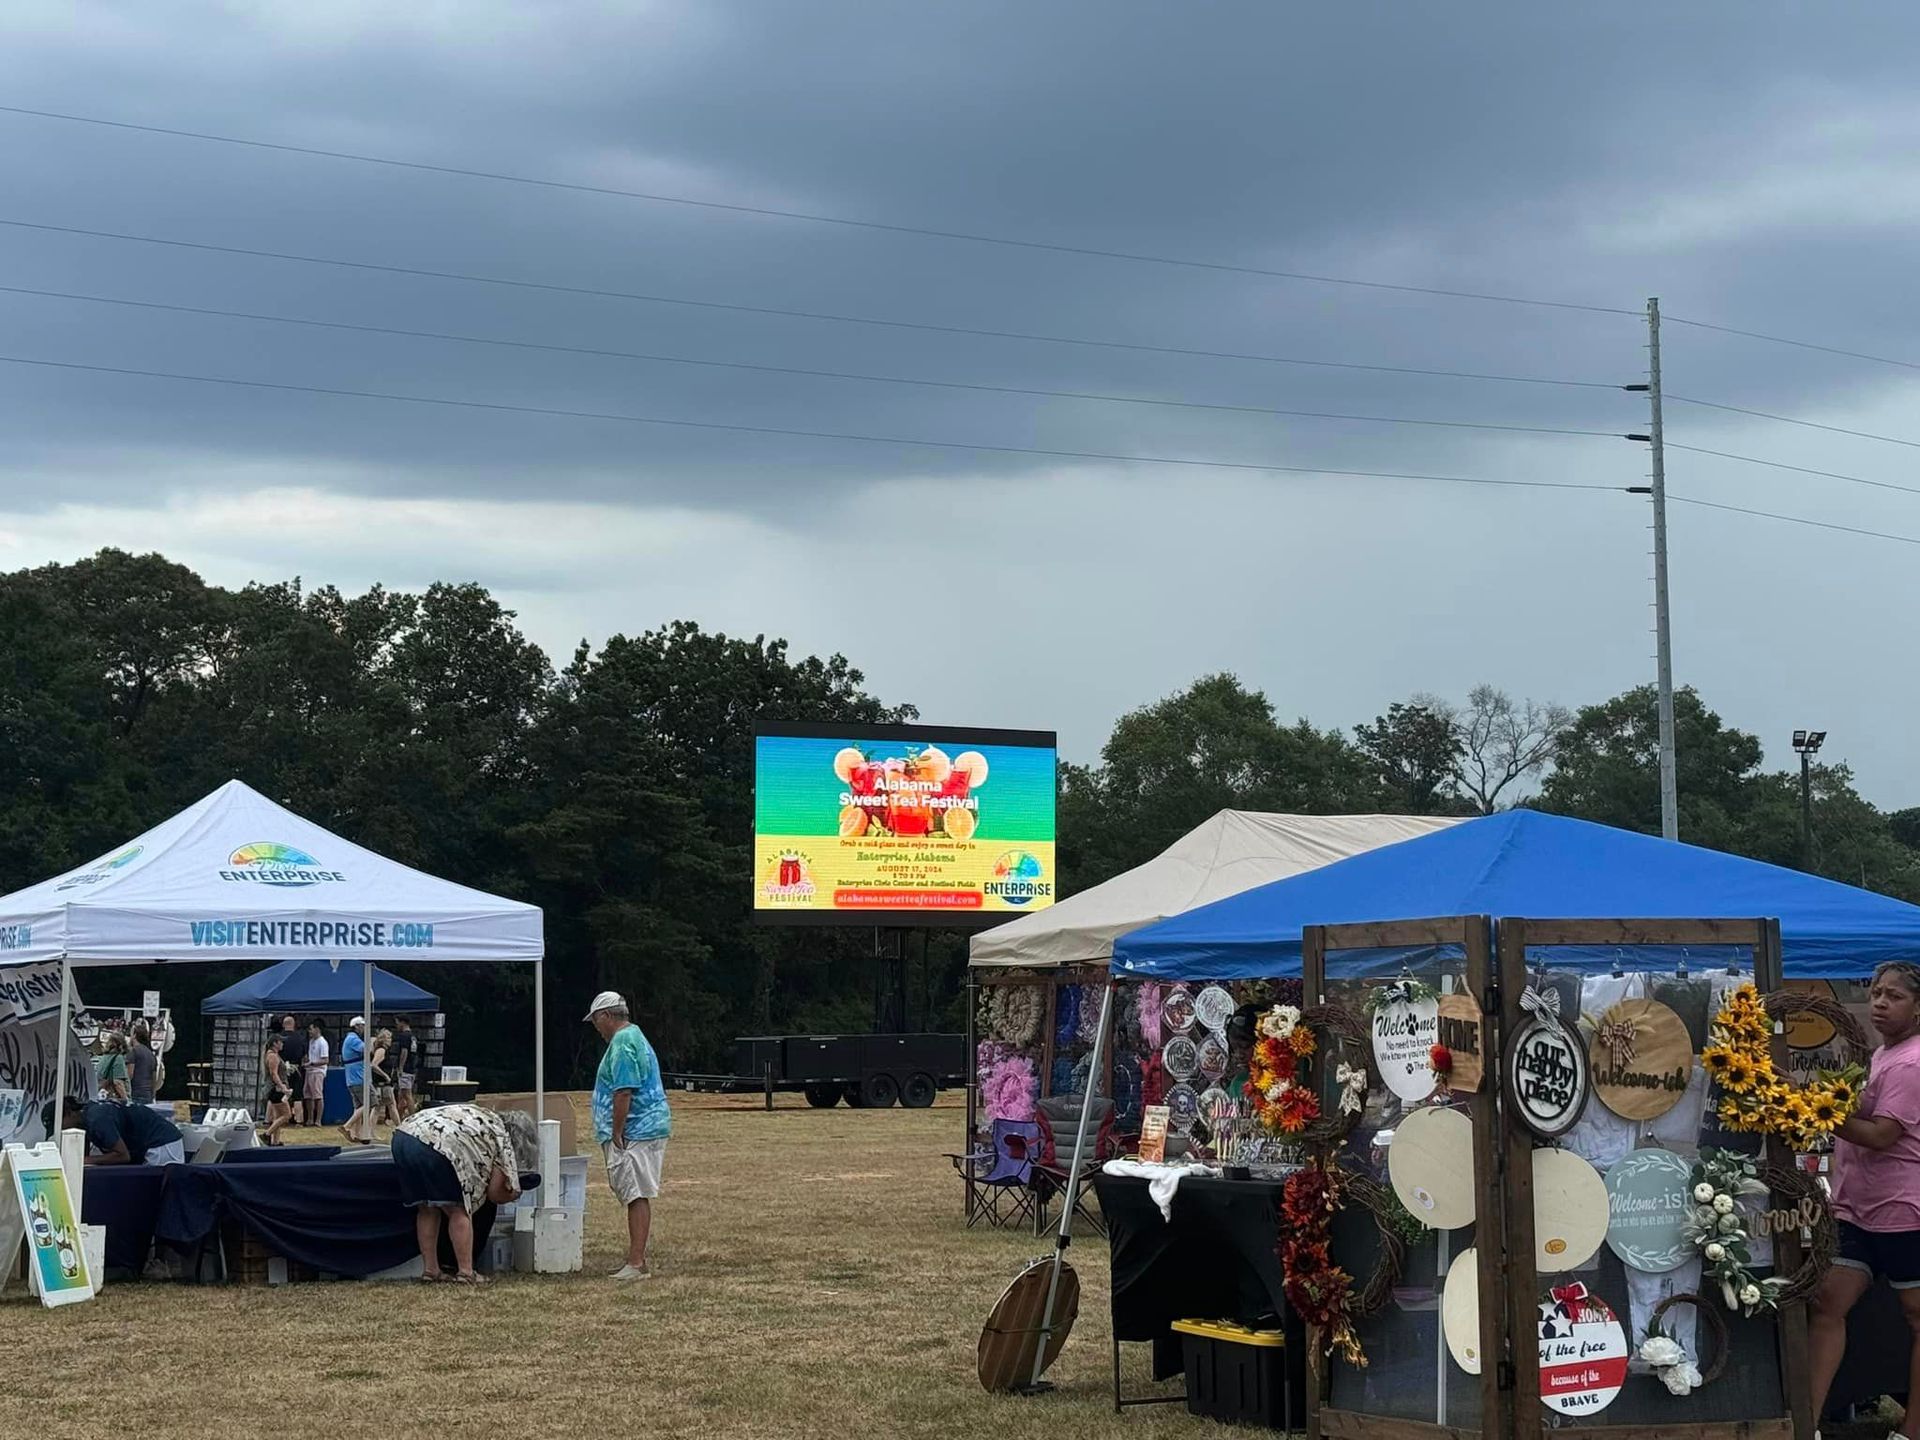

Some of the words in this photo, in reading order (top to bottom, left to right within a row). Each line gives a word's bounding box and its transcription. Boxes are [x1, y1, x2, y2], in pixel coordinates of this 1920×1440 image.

[873, 777, 942, 792] Alabama
[838, 792, 889, 807] Sweet
[890, 793, 918, 808] Tea
[921, 794, 979, 810] Festival
[856, 851, 911, 864] Enterprise,
[913, 852, 956, 862] Alabama
[877, 865, 909, 873] AUGUST
[911, 865, 922, 873] 17,
[837, 880, 872, 888] Enterprise
[837, 894, 977, 906] alabamasweetteafestival.com
[1534, 1041, 1566, 1065] our
[1519, 1048, 1574, 1088] happy
[1524, 1078, 1569, 1110] place
[1540, 1344, 1551, 1362] of
[1556, 1344, 1576, 1357] the
[1580, 1341, 1606, 1358] free
[1551, 1374, 1579, 1386] because
[1580, 1370, 1588, 1387] of
[1588, 1369, 1600, 1381] the
[1561, 1394, 1599, 1408] BRAVE
